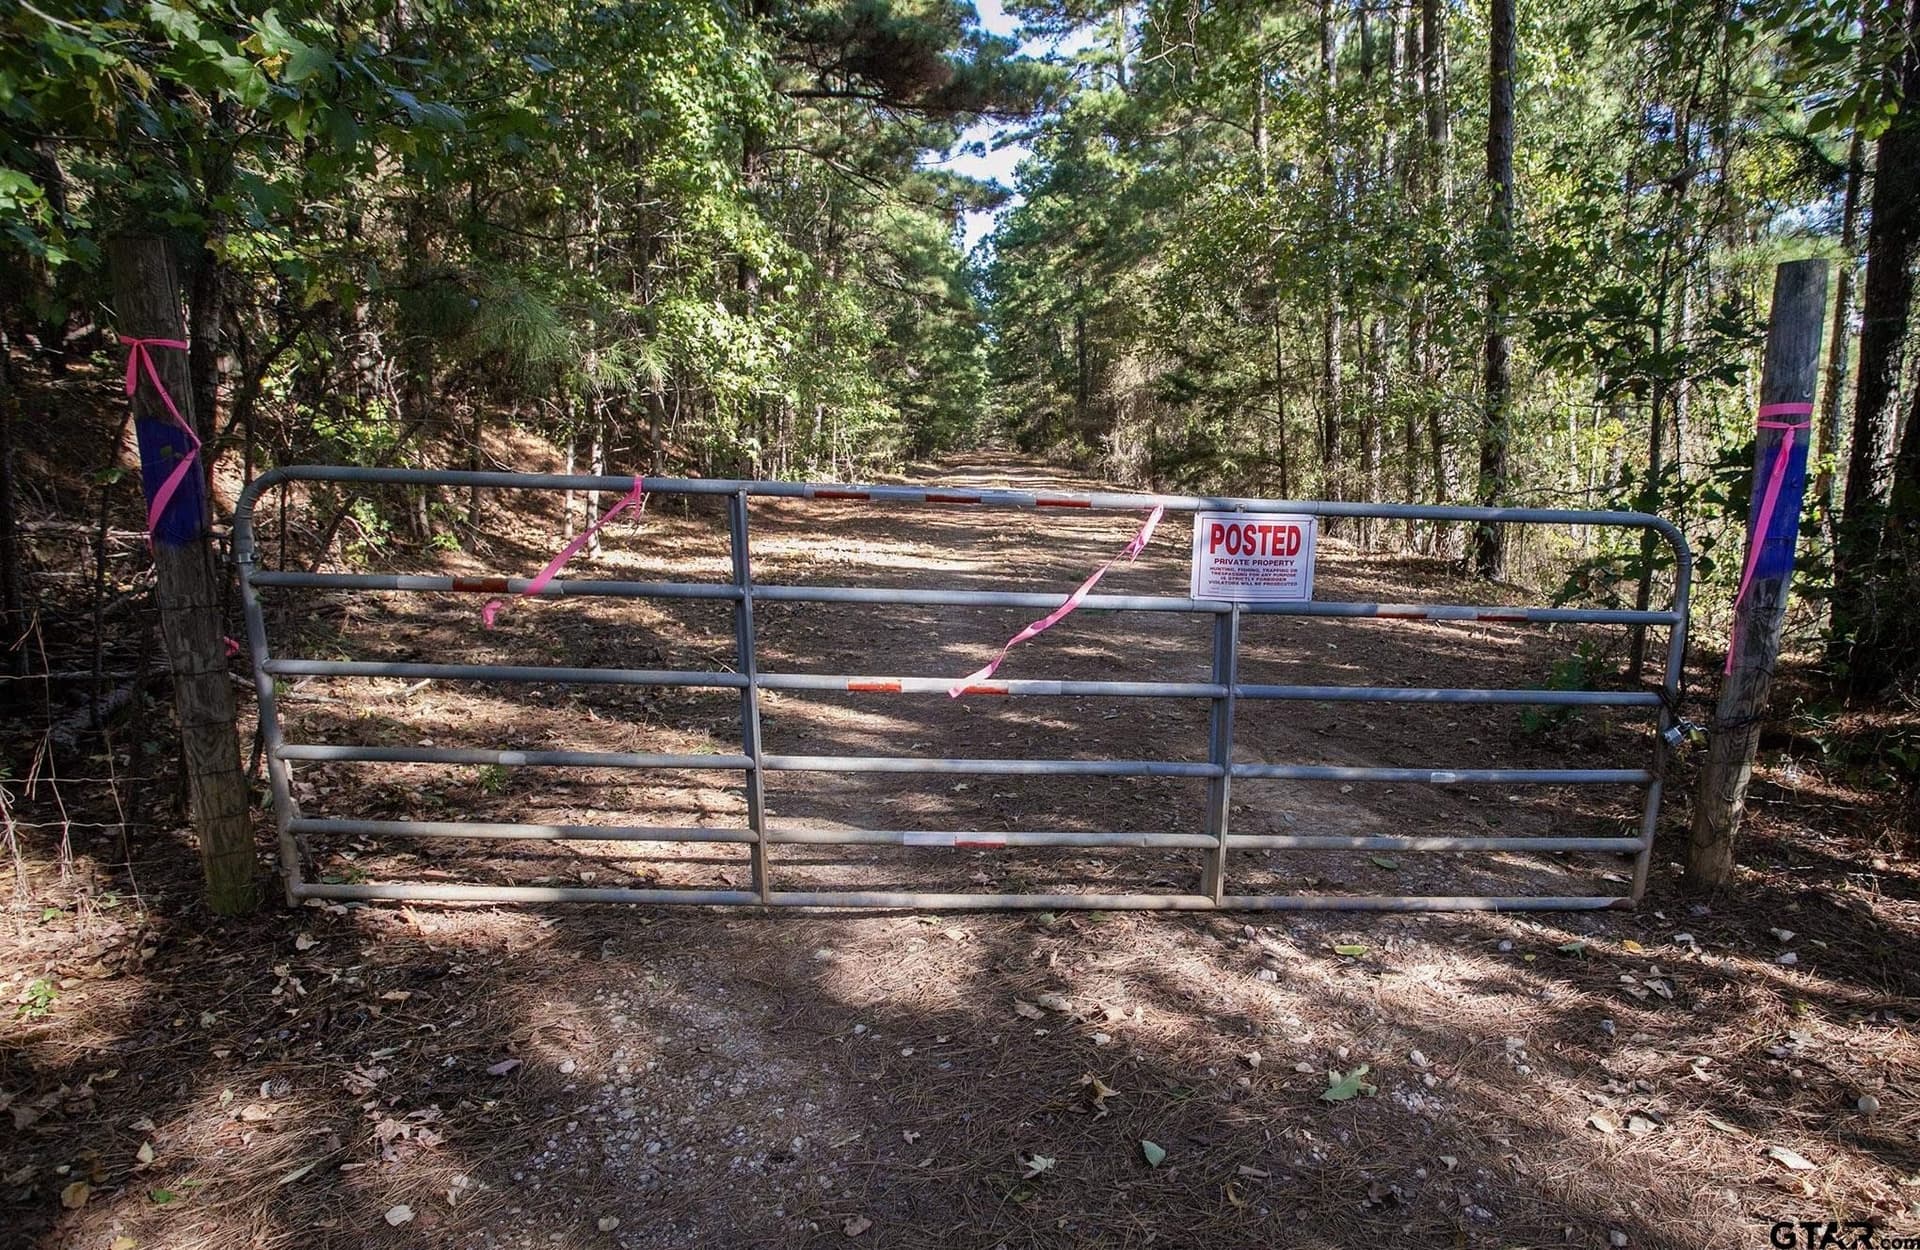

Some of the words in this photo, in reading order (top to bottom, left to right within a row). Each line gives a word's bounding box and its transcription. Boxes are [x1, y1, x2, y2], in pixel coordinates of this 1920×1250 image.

[1209, 523, 1302, 557] POSTED
[1213, 558, 1250, 566] PRIVATE
[1252, 559, 1295, 567] PROPERTY
